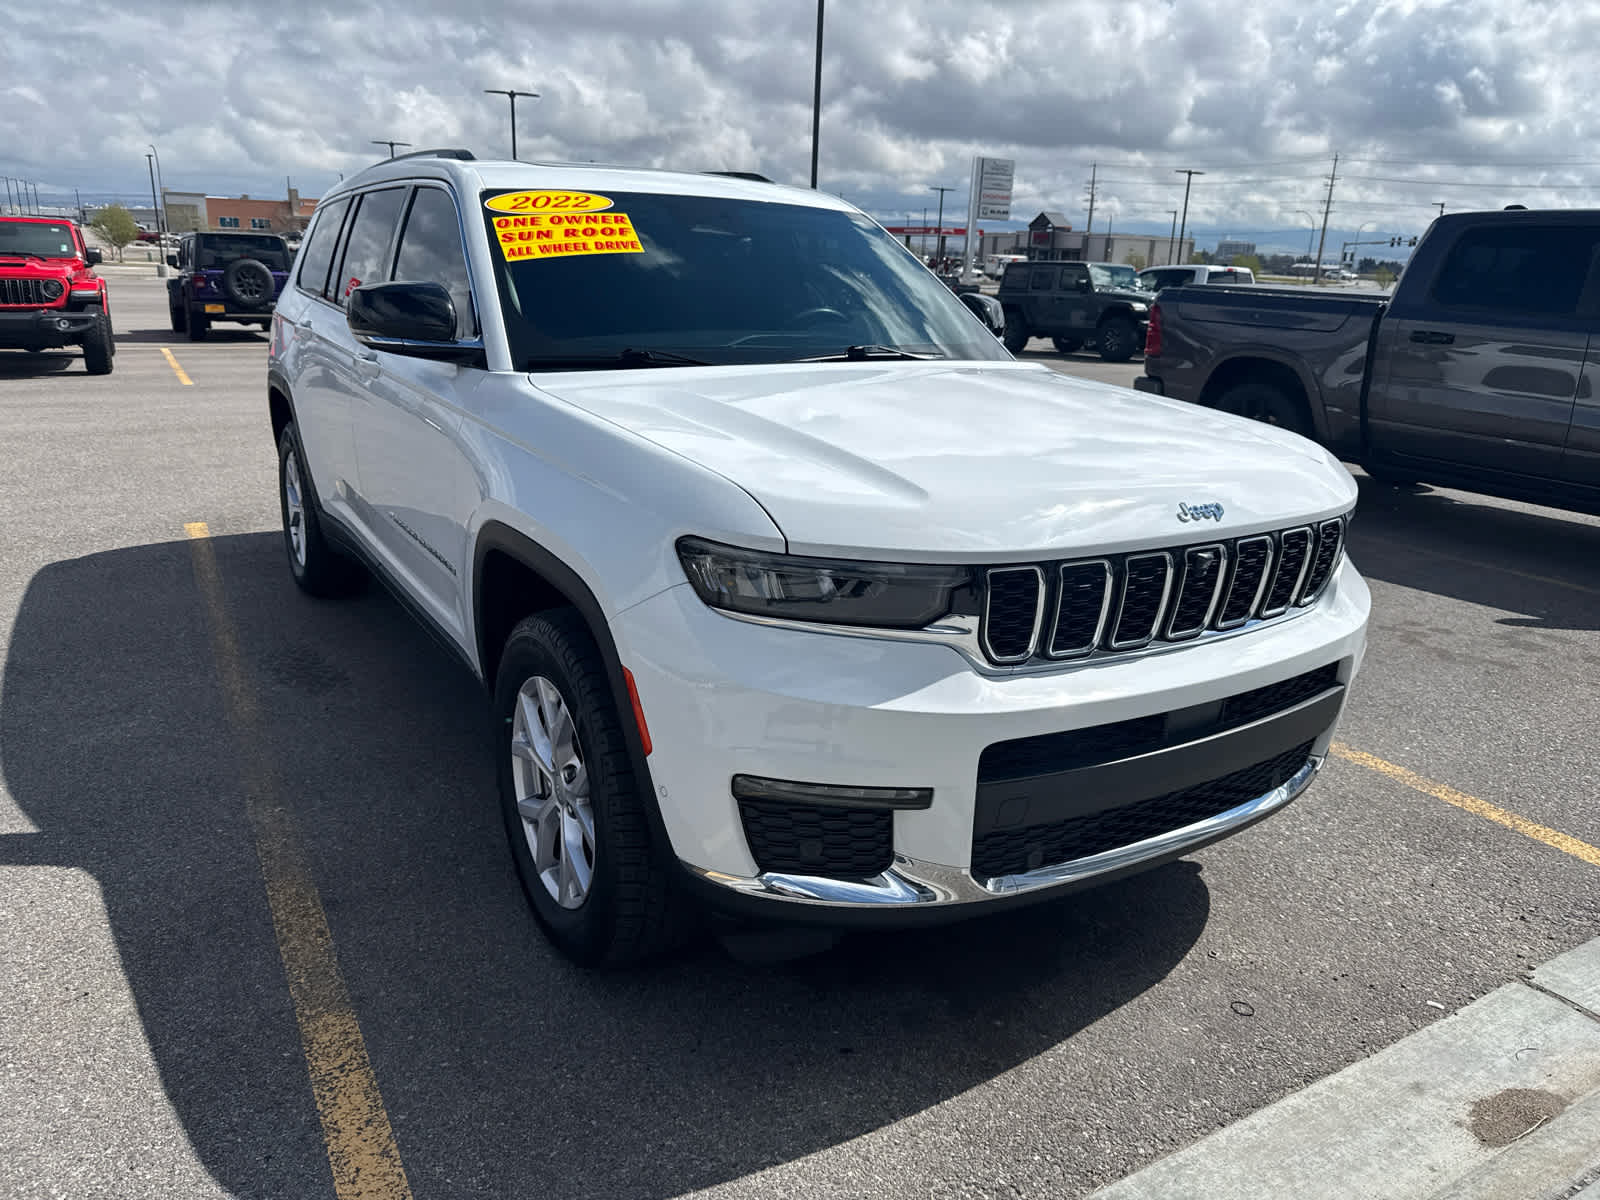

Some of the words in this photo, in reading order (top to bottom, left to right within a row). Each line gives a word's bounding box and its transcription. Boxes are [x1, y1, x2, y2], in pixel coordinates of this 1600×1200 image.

[509, 195, 591, 210] 2022
[496, 216, 543, 228] ONE
[549, 215, 628, 225] OWNER
[501, 229, 553, 243] SUN
[563, 227, 632, 237] ROOF
[507, 246, 534, 257] ALL
[538, 242, 592, 255] WHEEL
[595, 240, 640, 250] DRIVE
[1176, 502, 1224, 523] Jeep
